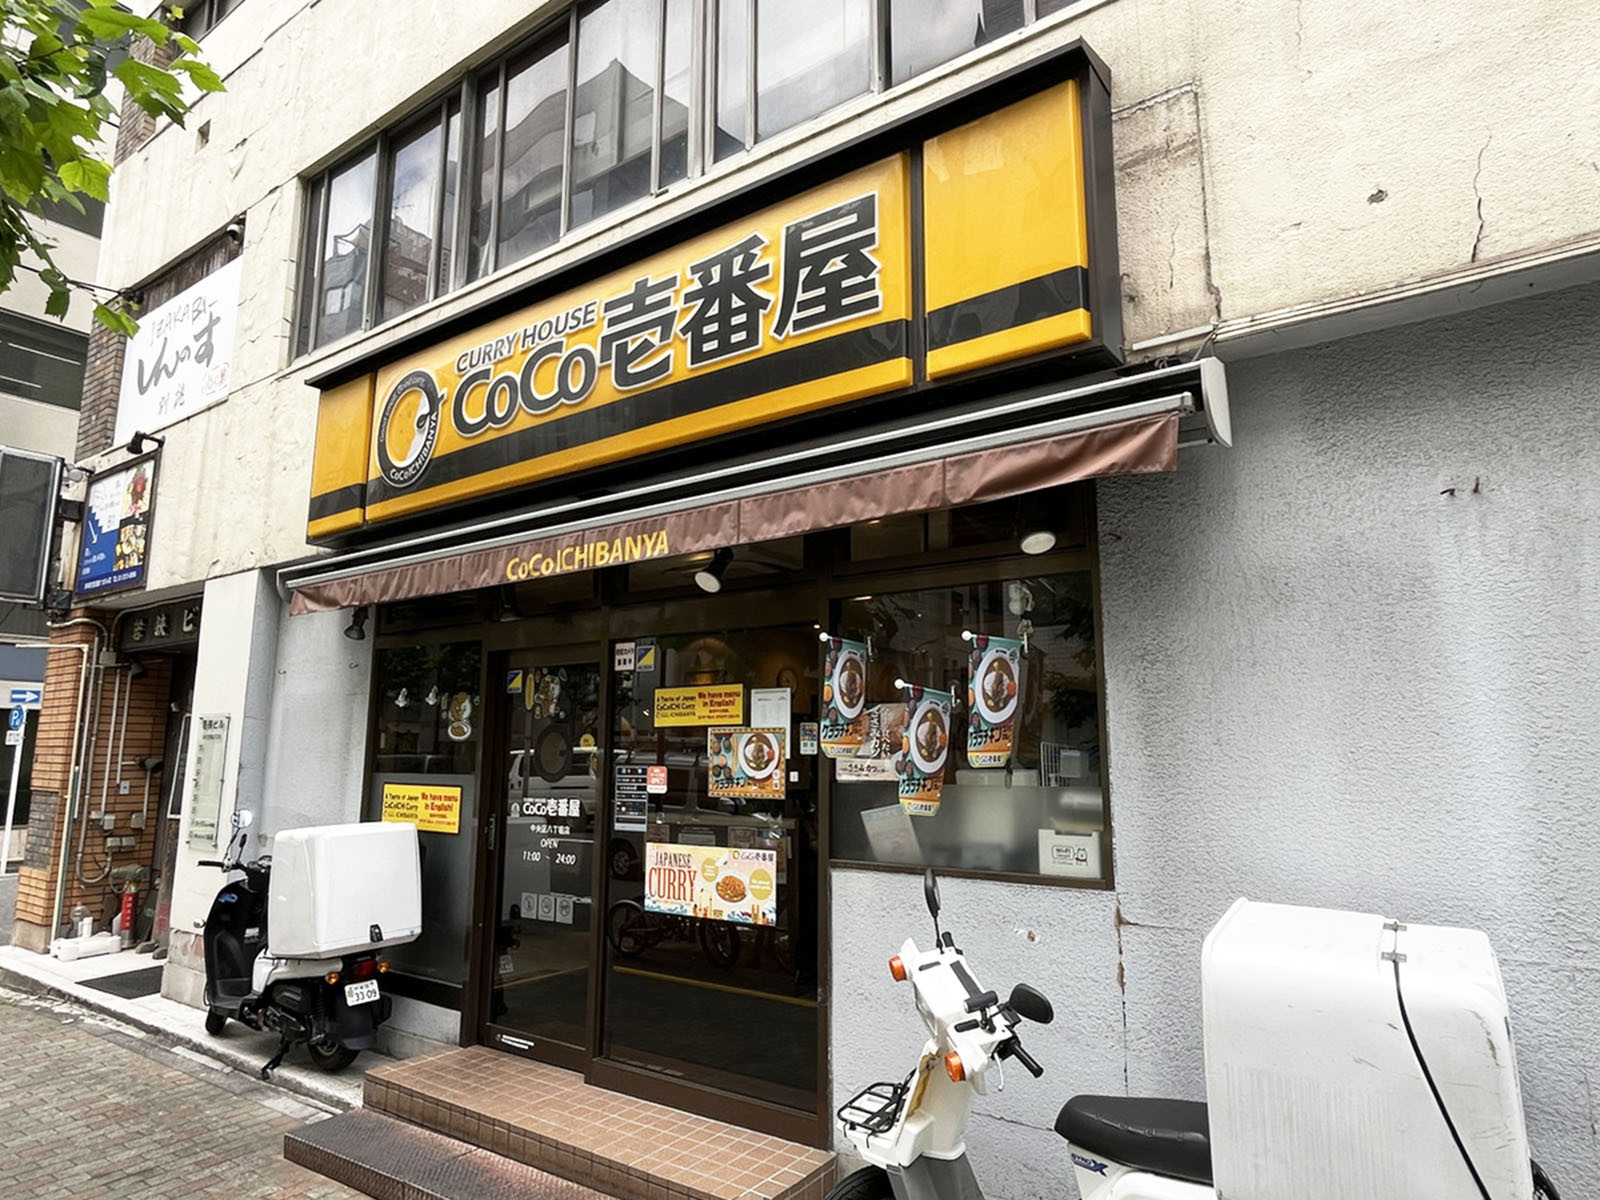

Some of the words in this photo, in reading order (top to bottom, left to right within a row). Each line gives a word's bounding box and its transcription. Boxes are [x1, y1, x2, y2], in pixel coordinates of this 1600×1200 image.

[456, 332, 518, 374] CURRY
[521, 301, 598, 349] HOUSE
[540, 838, 559, 848] OPEN
[523, 851, 541, 862] 11:00
[555, 853, 577, 865] 24:00
[655, 851, 693, 869] JAPANESE
[648, 866, 698, 902] CURRY
